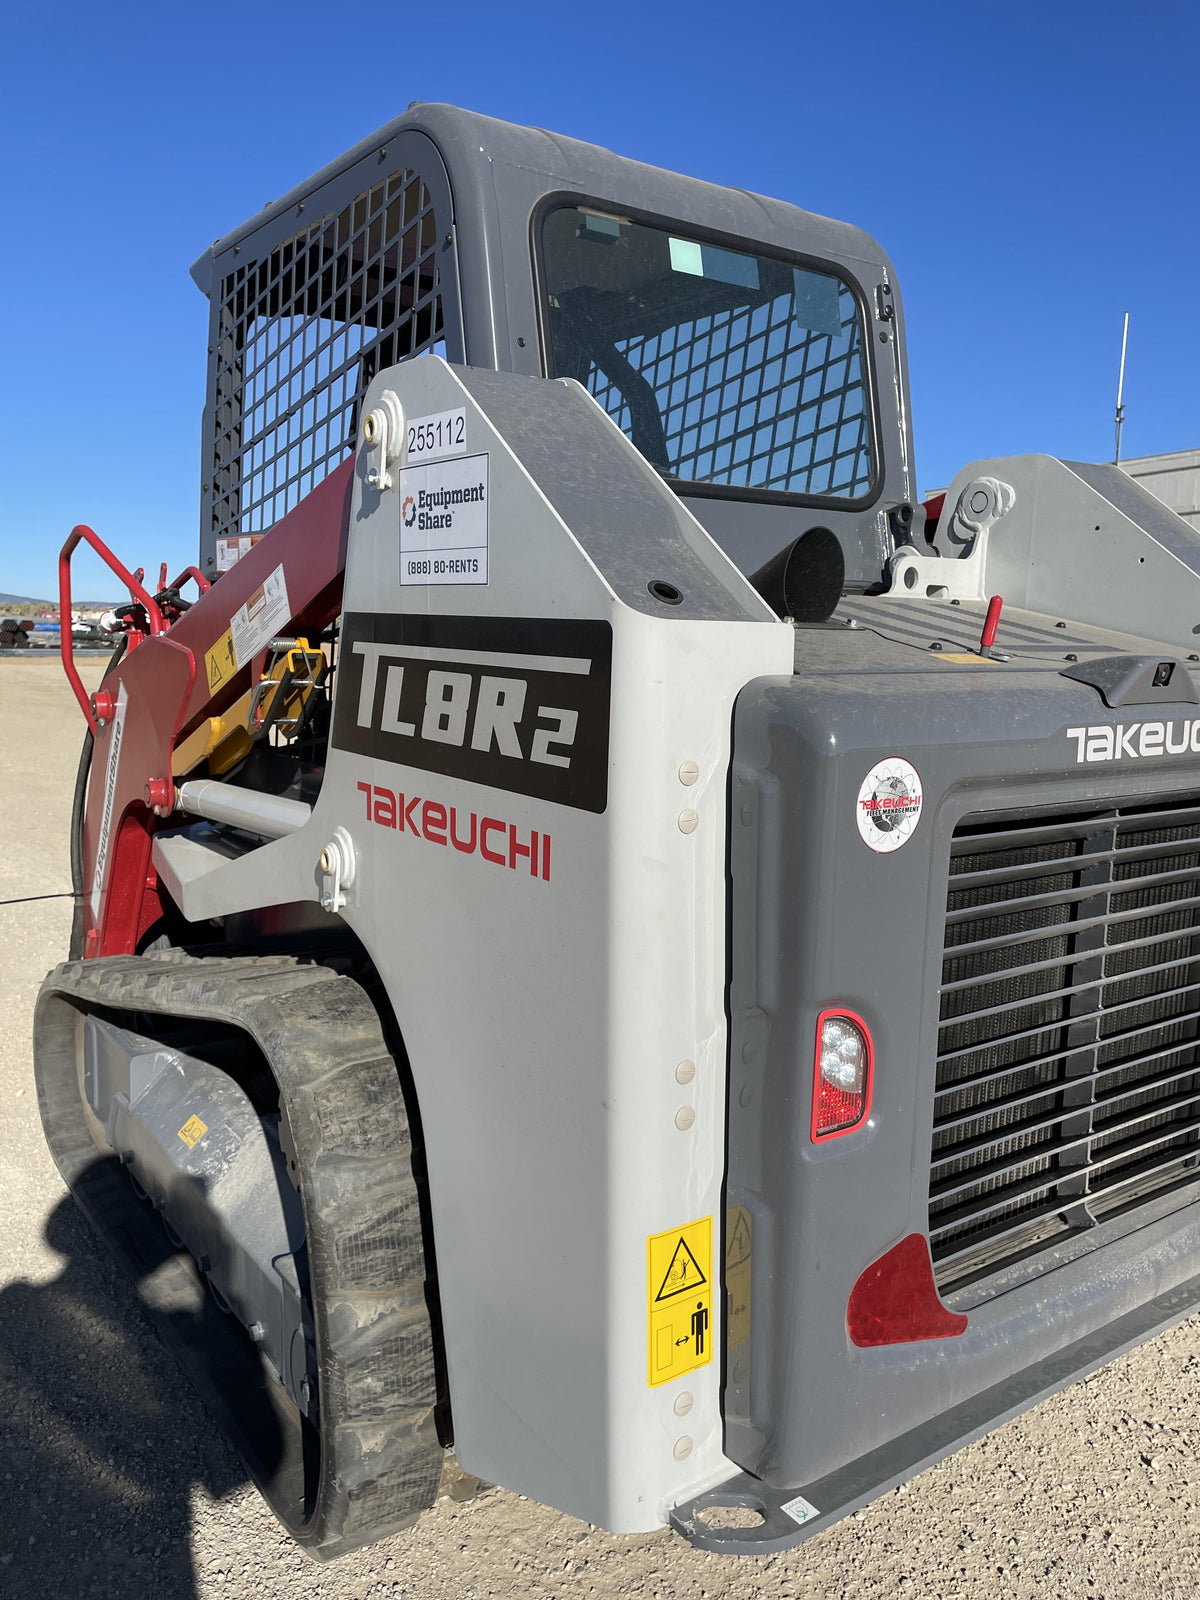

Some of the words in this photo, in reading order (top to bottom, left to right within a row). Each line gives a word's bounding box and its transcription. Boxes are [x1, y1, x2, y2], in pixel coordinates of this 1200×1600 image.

[407, 416, 465, 453] 255112
[417, 482, 484, 511] Equipment
[417, 511, 452, 530] Share
[407, 560, 431, 575] (888)
[433, 559, 479, 574] 80-RENTS
[352, 641, 592, 769] TL8R2
[98, 720, 122, 873] EquipmentShare
[866, 809, 882, 817] FLEET
[882, 805, 920, 816] MANAGEMENT
